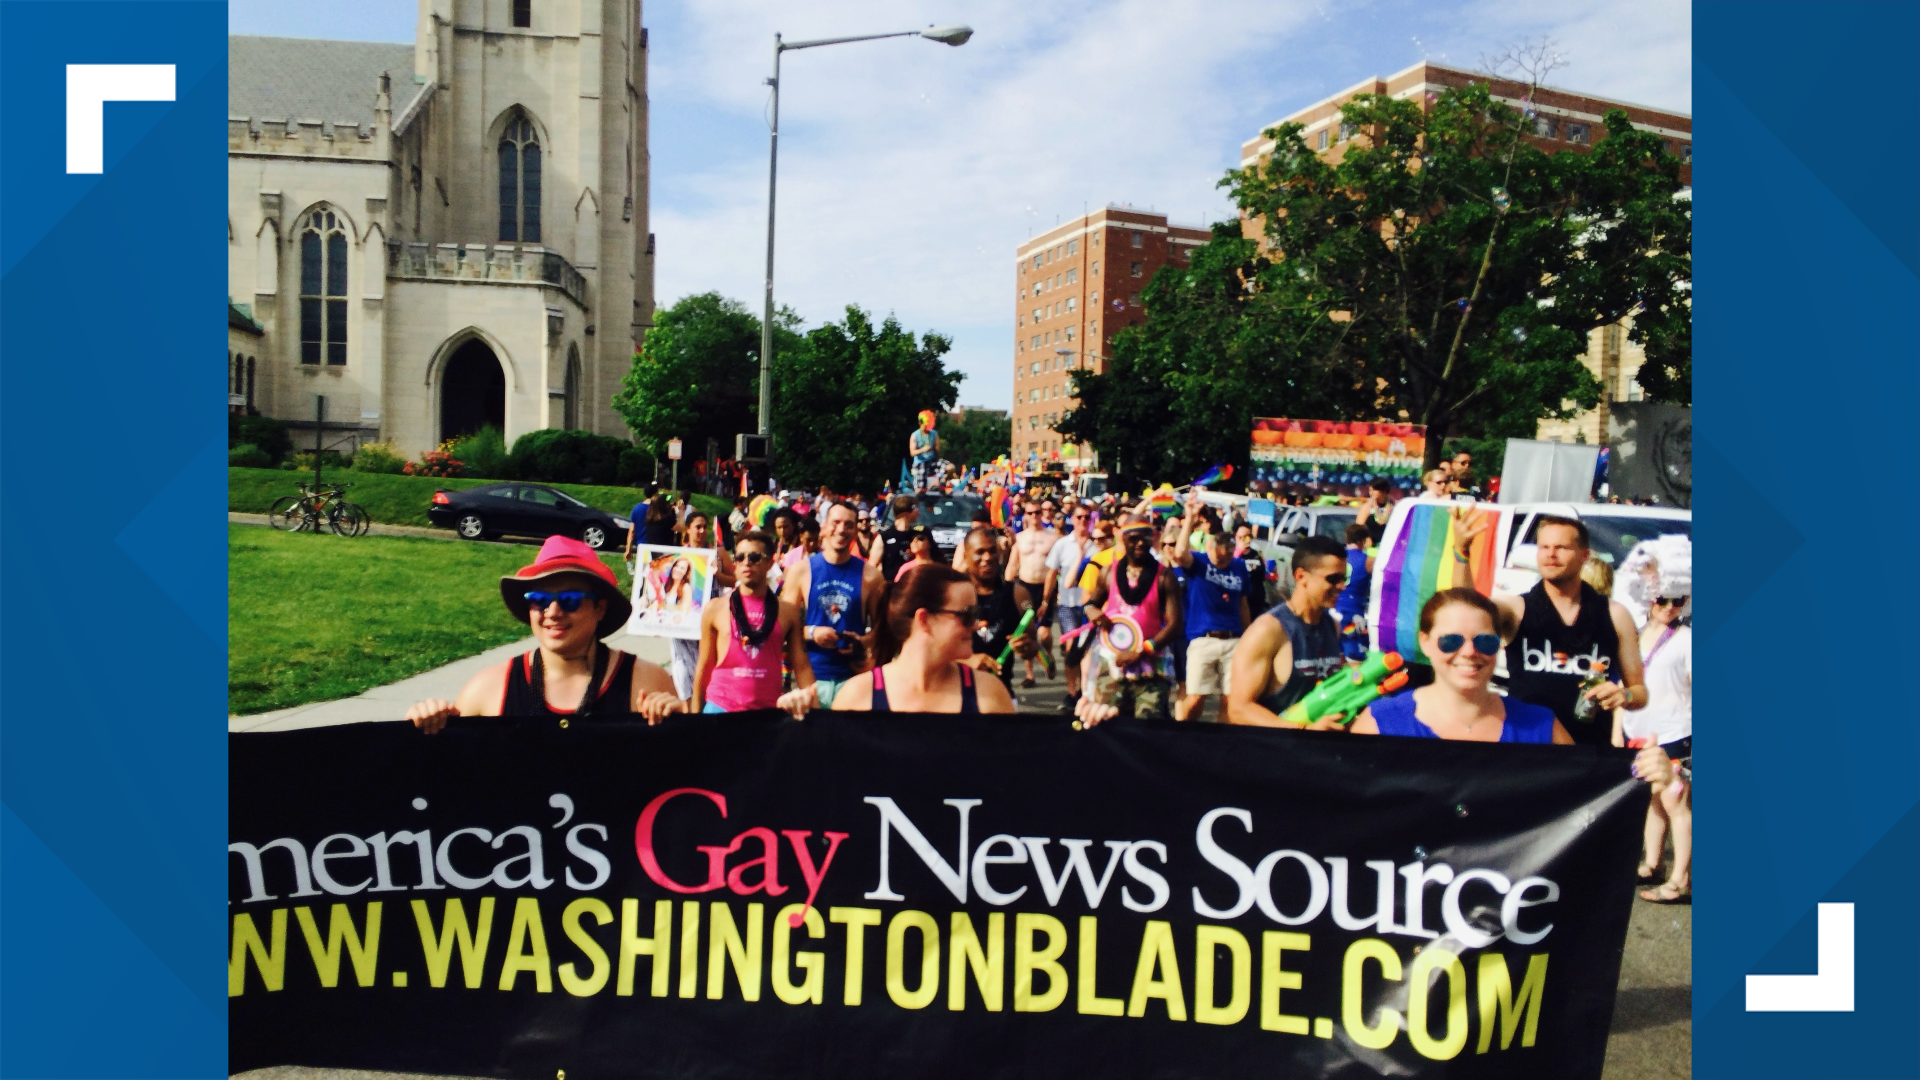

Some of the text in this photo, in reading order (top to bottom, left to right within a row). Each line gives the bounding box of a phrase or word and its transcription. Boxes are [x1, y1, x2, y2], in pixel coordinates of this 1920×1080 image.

[1365, 449, 1423, 469] thrive
[1205, 563, 1242, 587] blade
[1522, 637, 1611, 677] blade
[635, 788, 849, 929] Gay
[863, 796, 1170, 913] News
[1192, 807, 1561, 947] Source
